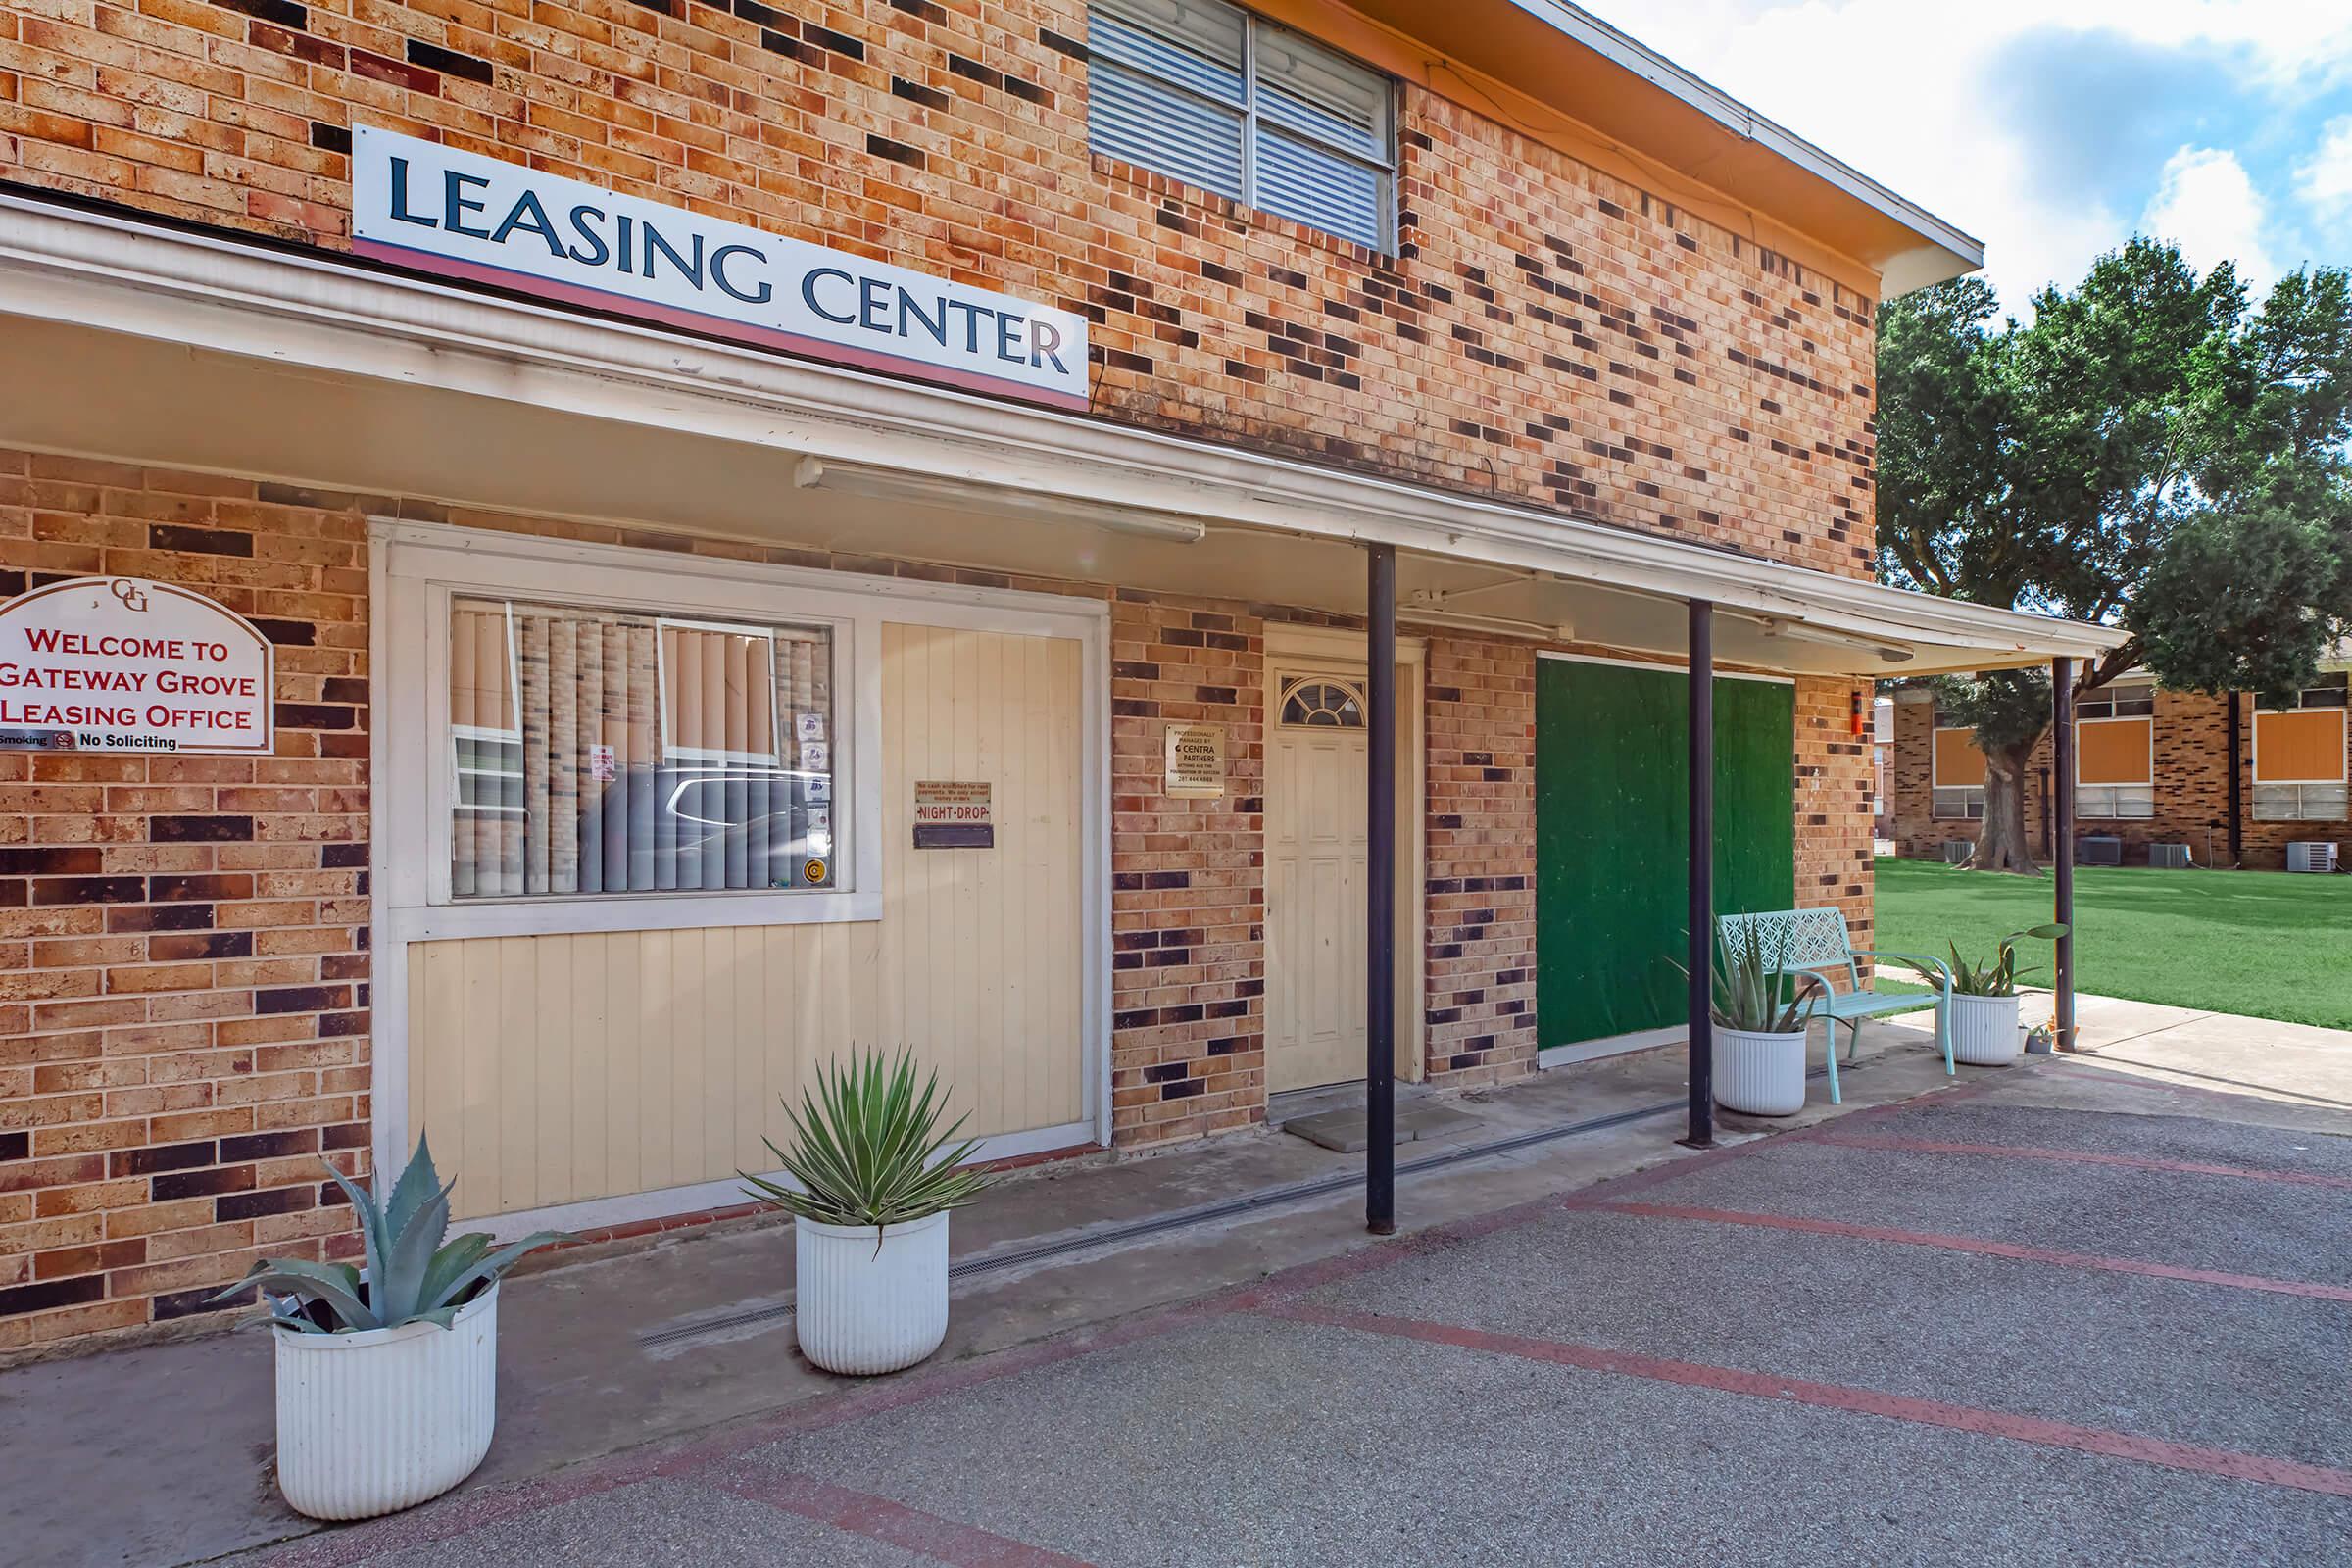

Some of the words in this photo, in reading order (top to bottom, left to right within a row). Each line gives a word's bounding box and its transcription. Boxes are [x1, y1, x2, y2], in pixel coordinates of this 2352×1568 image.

[389, 156, 773, 305] LEASING
[802, 267, 1070, 375] CENTER
[24, 627, 184, 660] WELCOME
[192, 642, 228, 662] TO
[0, 662, 147, 692] GATEWAY
[156, 670, 256, 697] GROVE
[0, 699, 136, 726] LEASING
[146, 705, 252, 730] OFFICE
[80, 734, 101, 746] No
[106, 735, 176, 751] Soliciting
[1183, 745, 1215, 754] CENTRA
